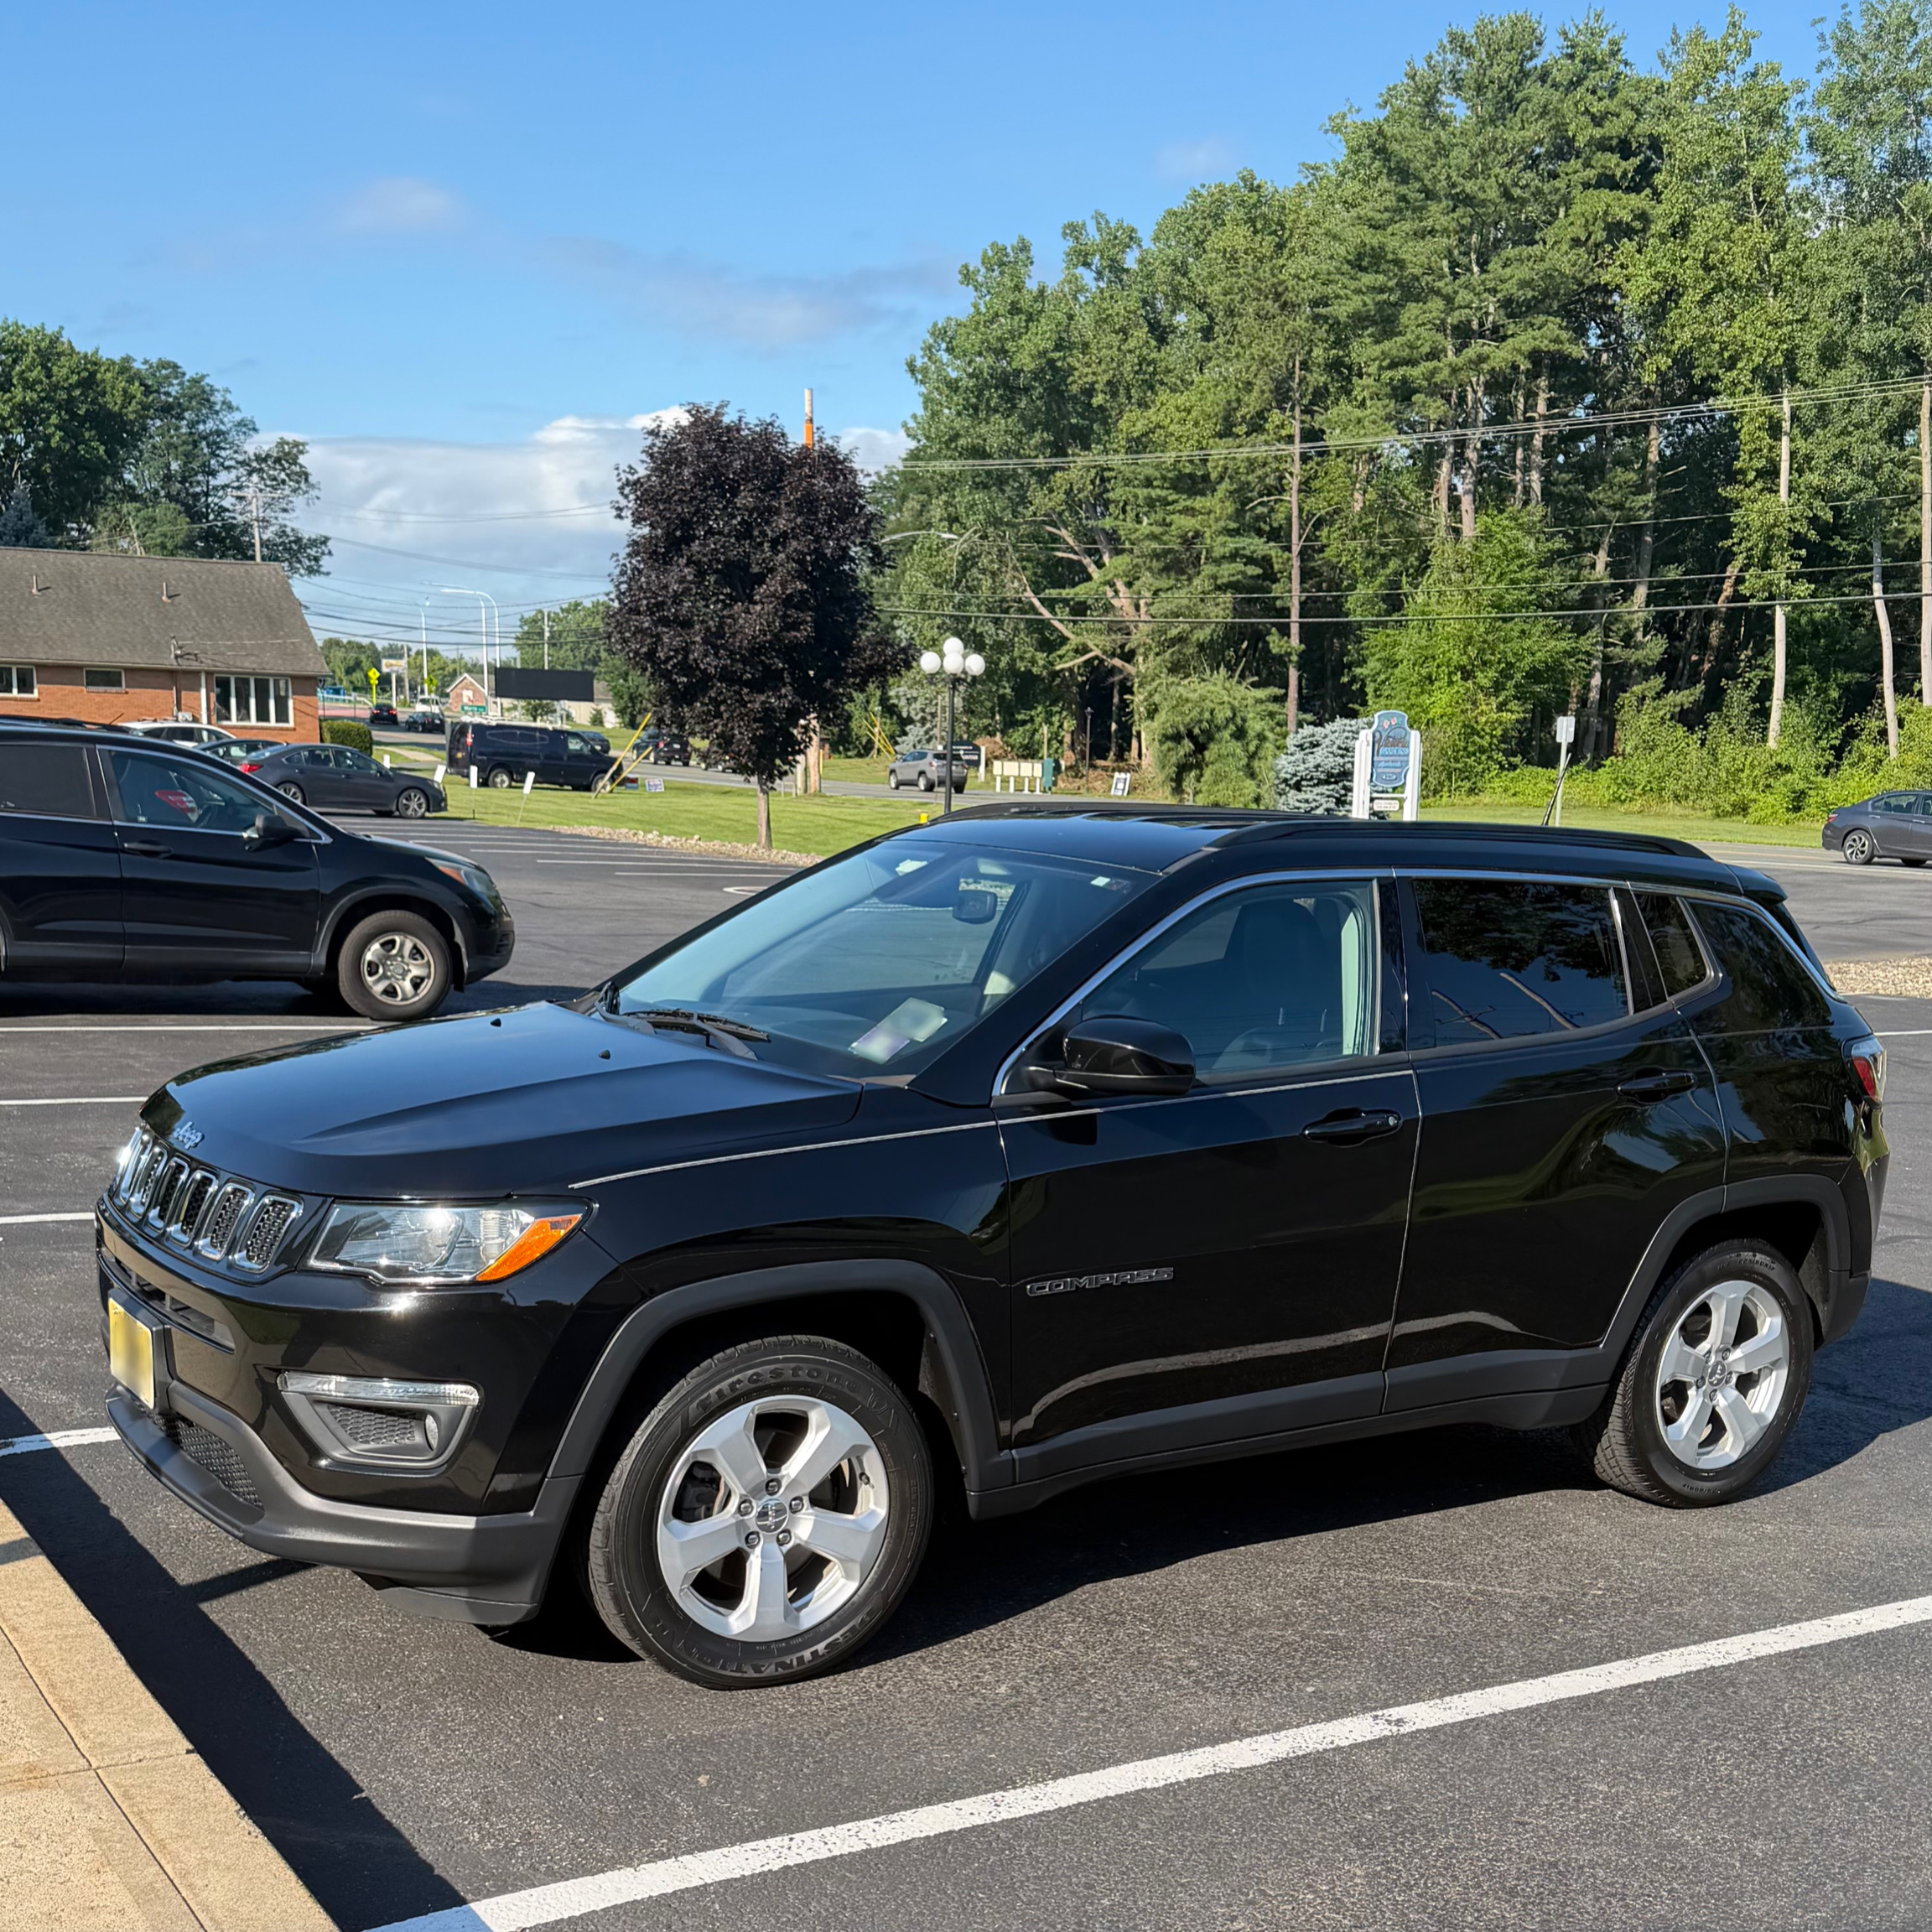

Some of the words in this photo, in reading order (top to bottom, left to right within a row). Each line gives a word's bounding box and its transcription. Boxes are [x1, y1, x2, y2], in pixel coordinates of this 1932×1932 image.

[173, 1121, 203, 1150] Jeep
[1026, 1267, 1174, 1296] COMPASS
[695, 1364, 860, 1413] Firestone
[676, 1609, 876, 1675] DESTINATION
